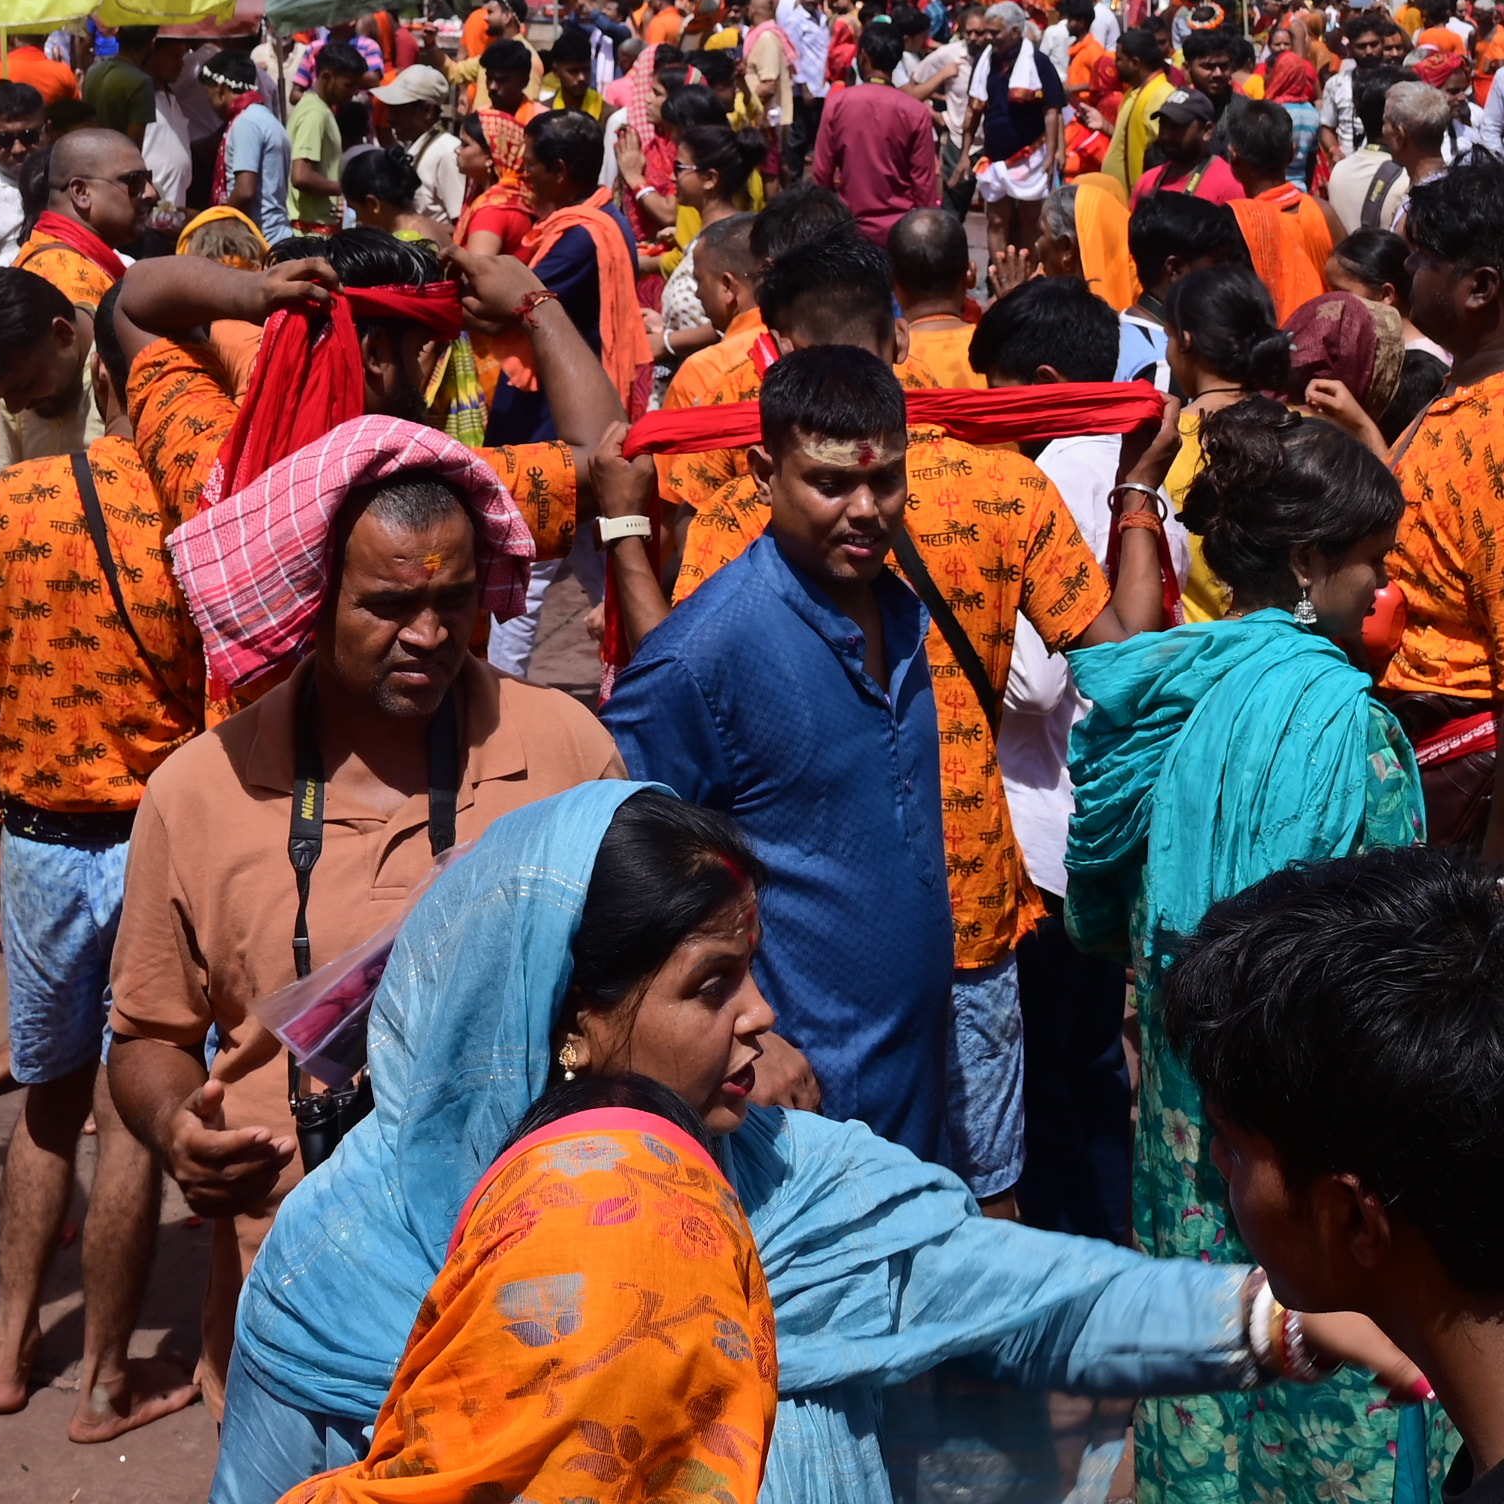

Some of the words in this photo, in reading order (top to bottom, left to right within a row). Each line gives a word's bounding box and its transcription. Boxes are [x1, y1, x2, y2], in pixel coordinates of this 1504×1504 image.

[910, 457, 973, 481] महाकाल
[9, 483, 61, 505] महाकाल
[103, 501, 162, 529] महाकाल
[919, 520, 980, 547] महाकाल
[301, 777, 317, 821] Nikon
